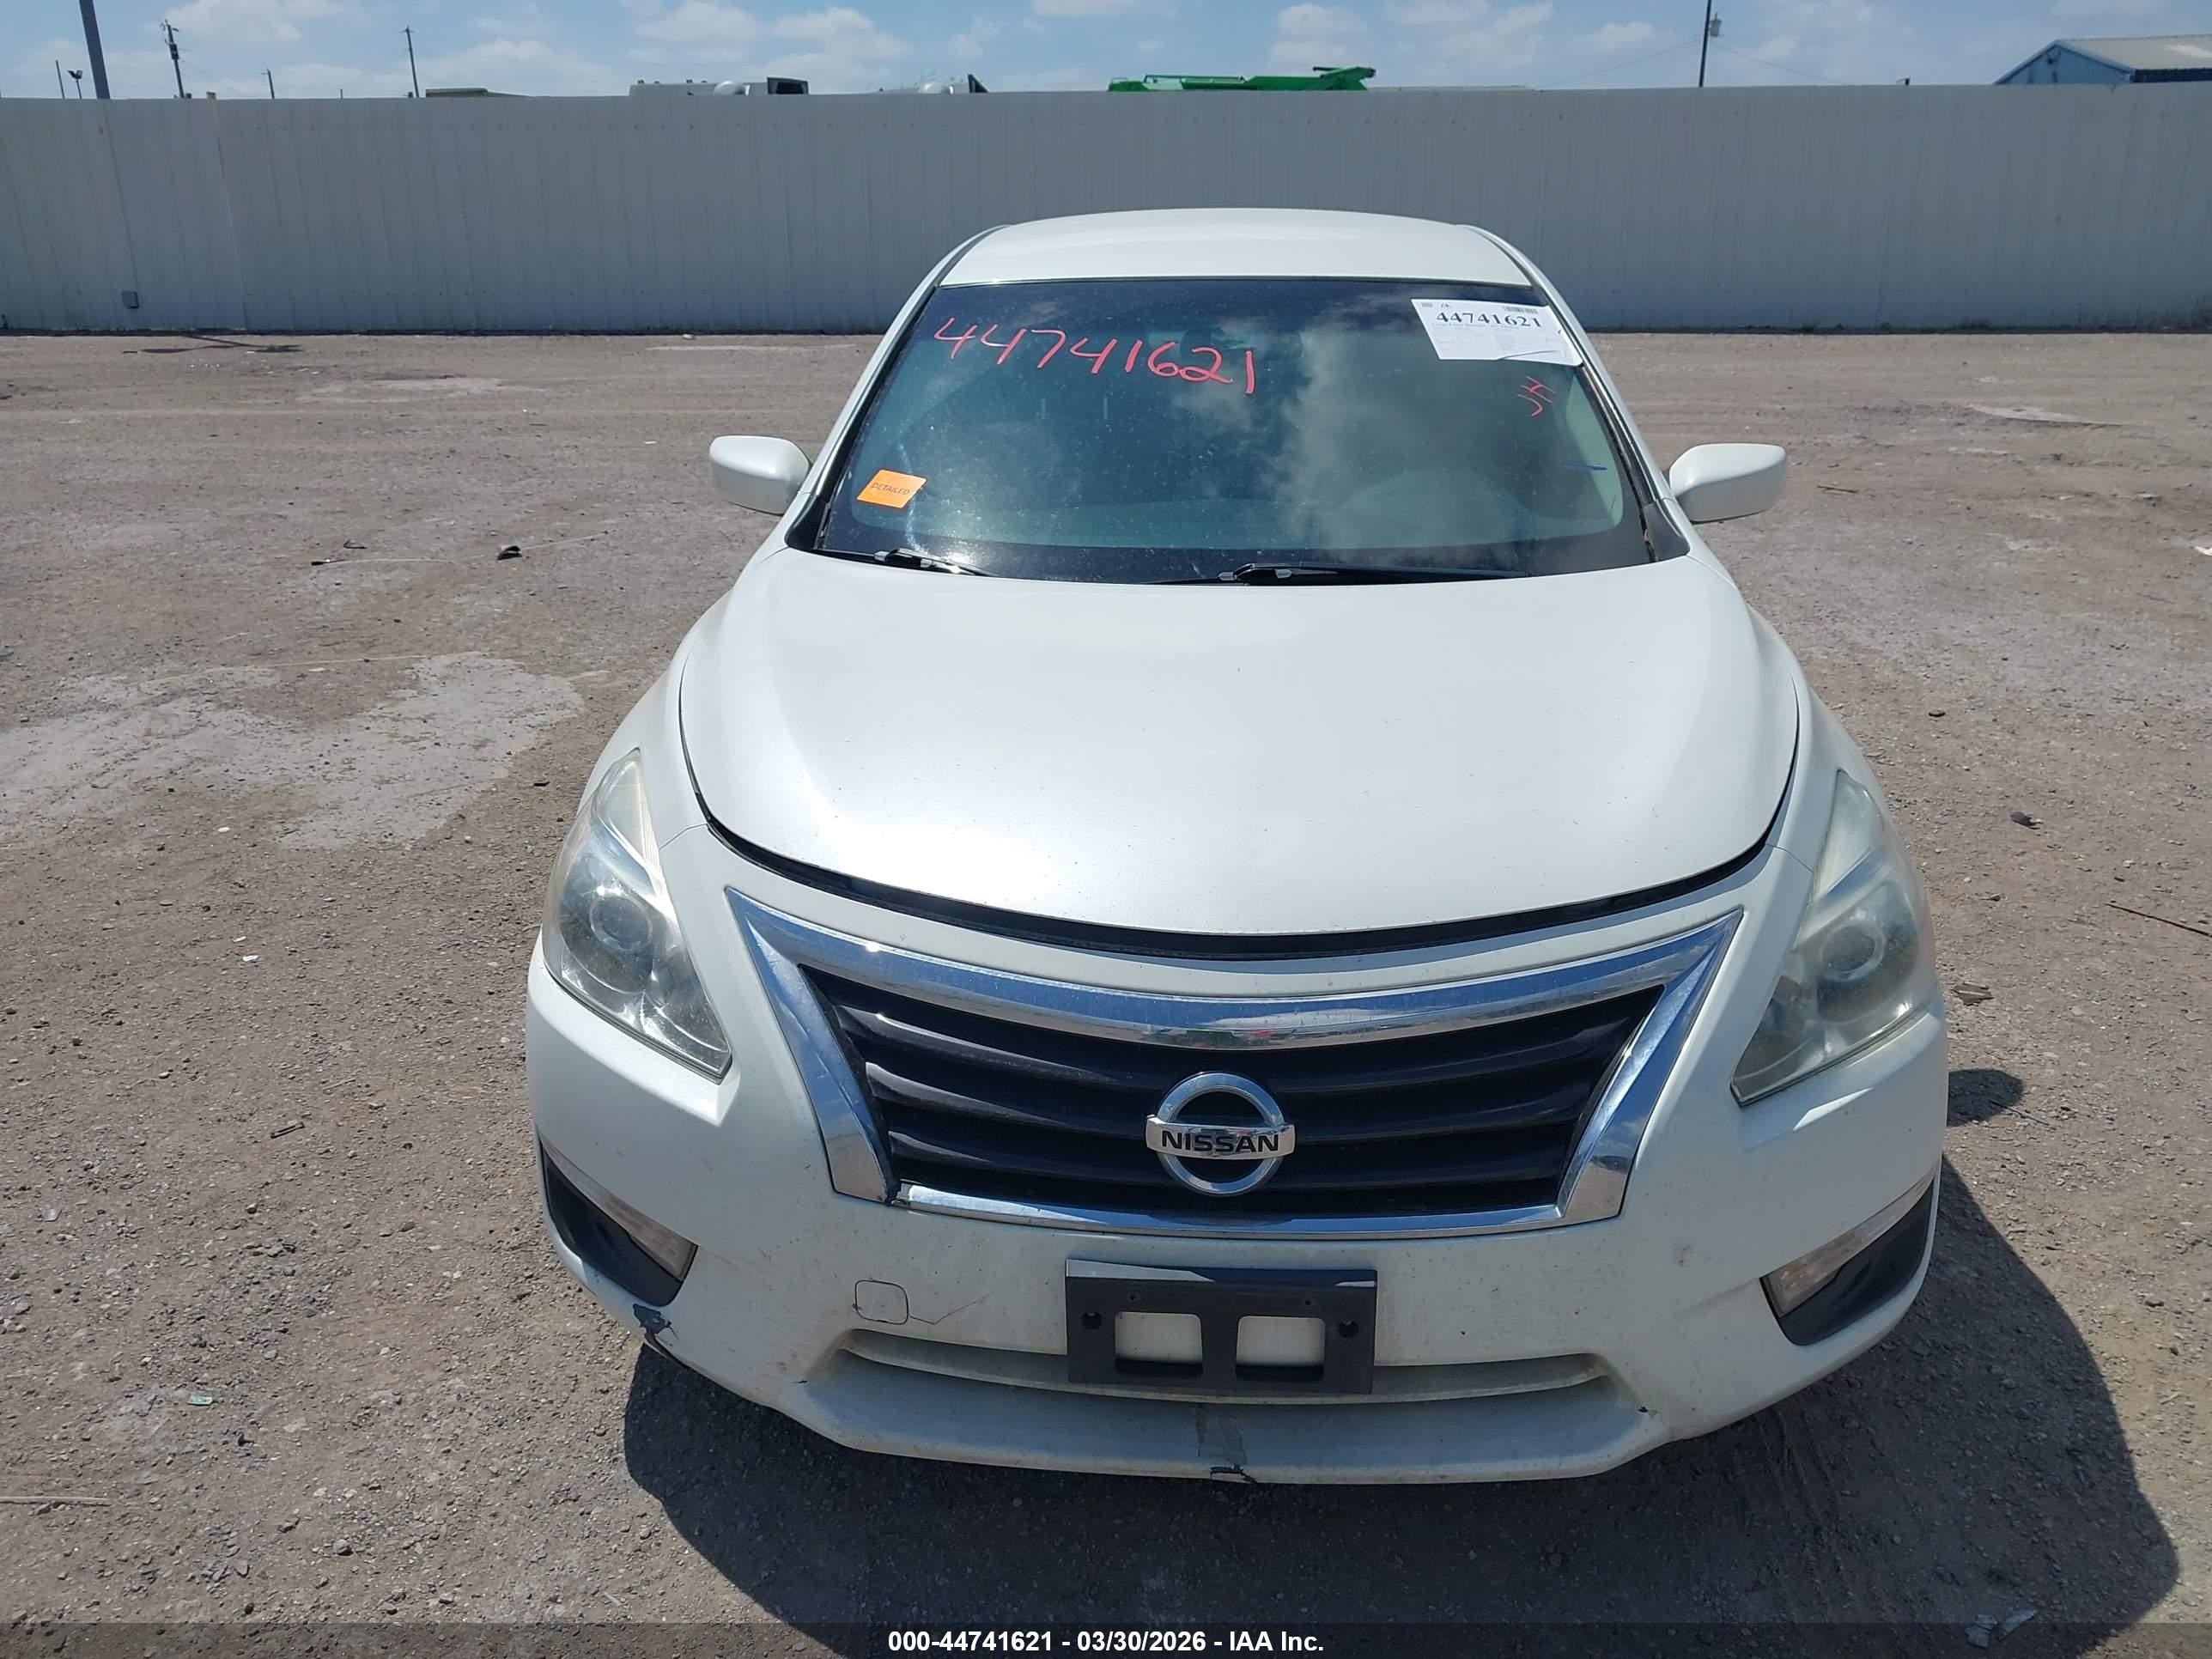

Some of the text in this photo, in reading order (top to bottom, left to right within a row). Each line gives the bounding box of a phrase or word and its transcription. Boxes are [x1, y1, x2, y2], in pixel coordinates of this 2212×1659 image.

[1436, 311, 1542, 328] 44741621
[933, 317, 1256, 395] 44741621
[871, 482, 911, 496] DETAILED
[1161, 1130, 1279, 1153] NISSAN
